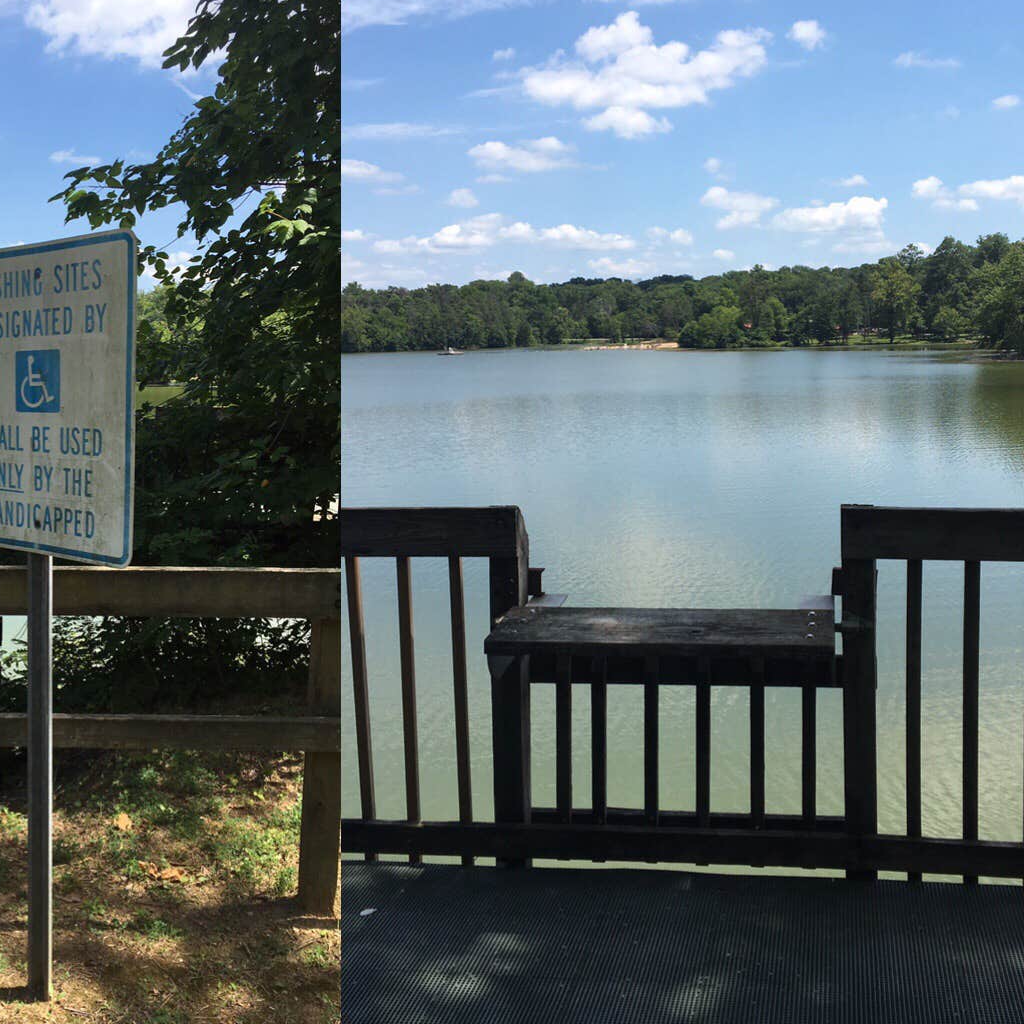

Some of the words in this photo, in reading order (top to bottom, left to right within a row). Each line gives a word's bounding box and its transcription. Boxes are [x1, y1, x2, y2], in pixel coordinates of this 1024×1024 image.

[54, 259, 102, 293] SITES
[85, 303, 107, 333] BY
[31, 426, 50, 453] BE
[60, 427, 103, 456] USED
[34, 465, 54, 492] BY
[63, 468, 93, 497] THE
